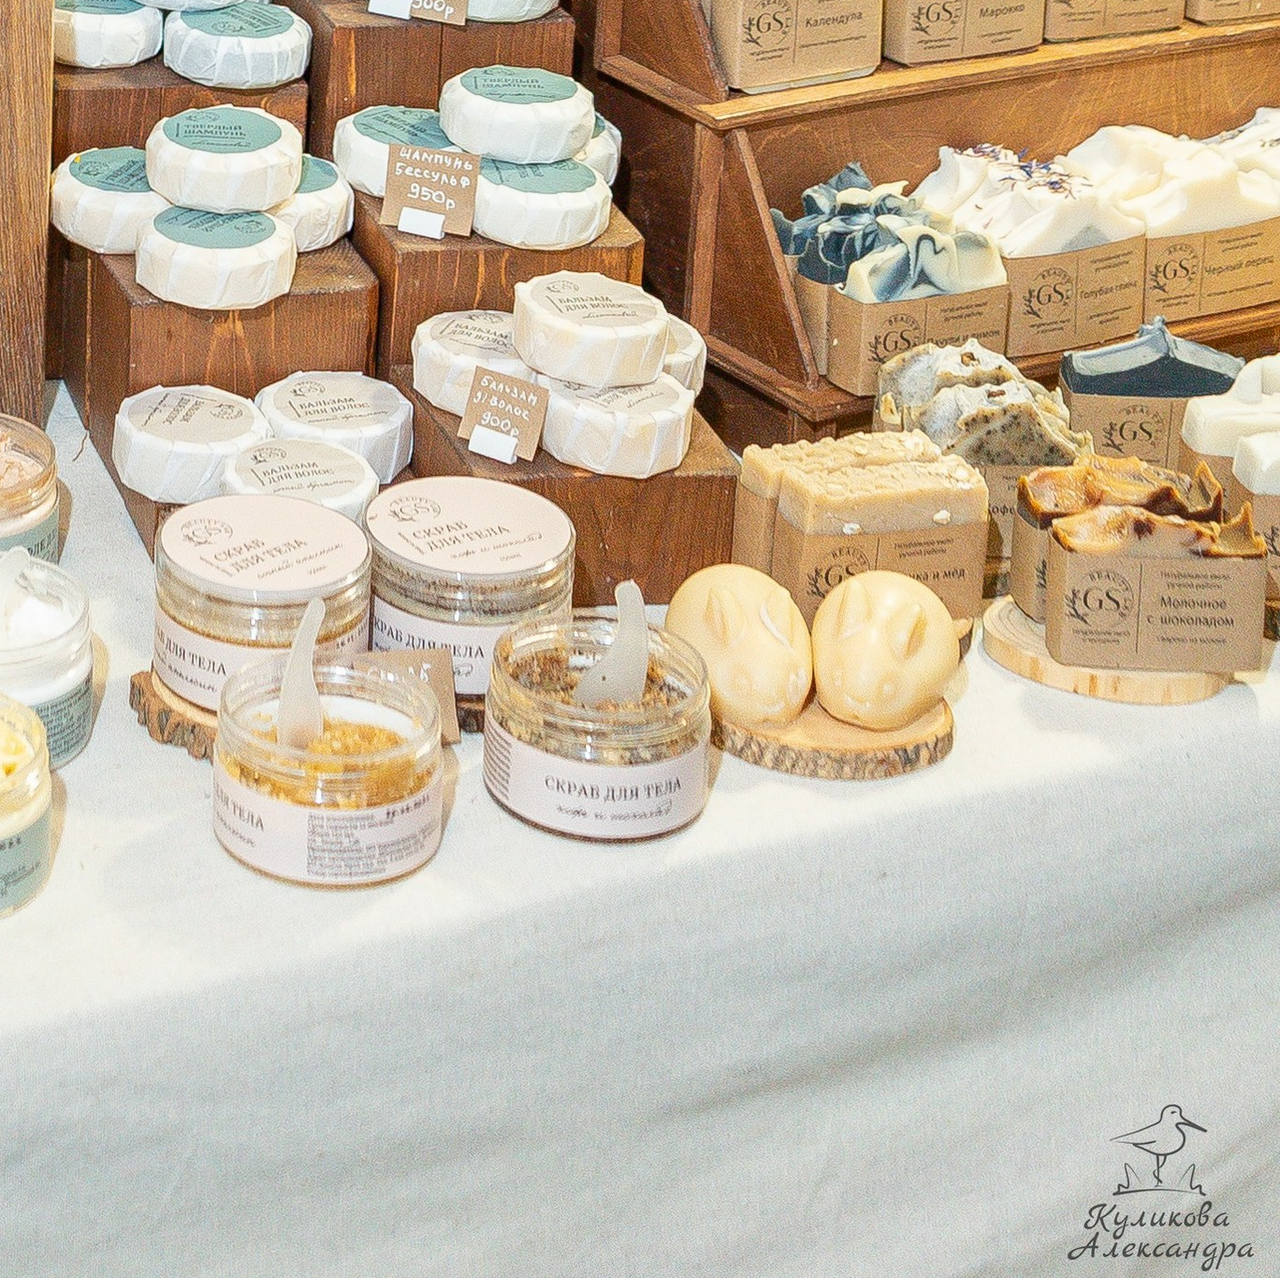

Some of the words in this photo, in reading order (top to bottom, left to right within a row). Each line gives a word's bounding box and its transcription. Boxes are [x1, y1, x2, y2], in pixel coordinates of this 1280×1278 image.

[756, 10, 784, 34] GS
[926, 1, 954, 23] GS
[406, 181, 457, 212] 950р
[1163, 258, 1191, 281] GS
[1037, 283, 1064, 306] GS
[883, 329, 912, 353] GS
[1120, 420, 1154, 443] GS
[1082, 586, 1121, 612] GS
[544, 773, 600, 801] СКРАБ
[601, 781, 643, 805] ДЛЯ
[643, 775, 683, 802] ТЕЛА
